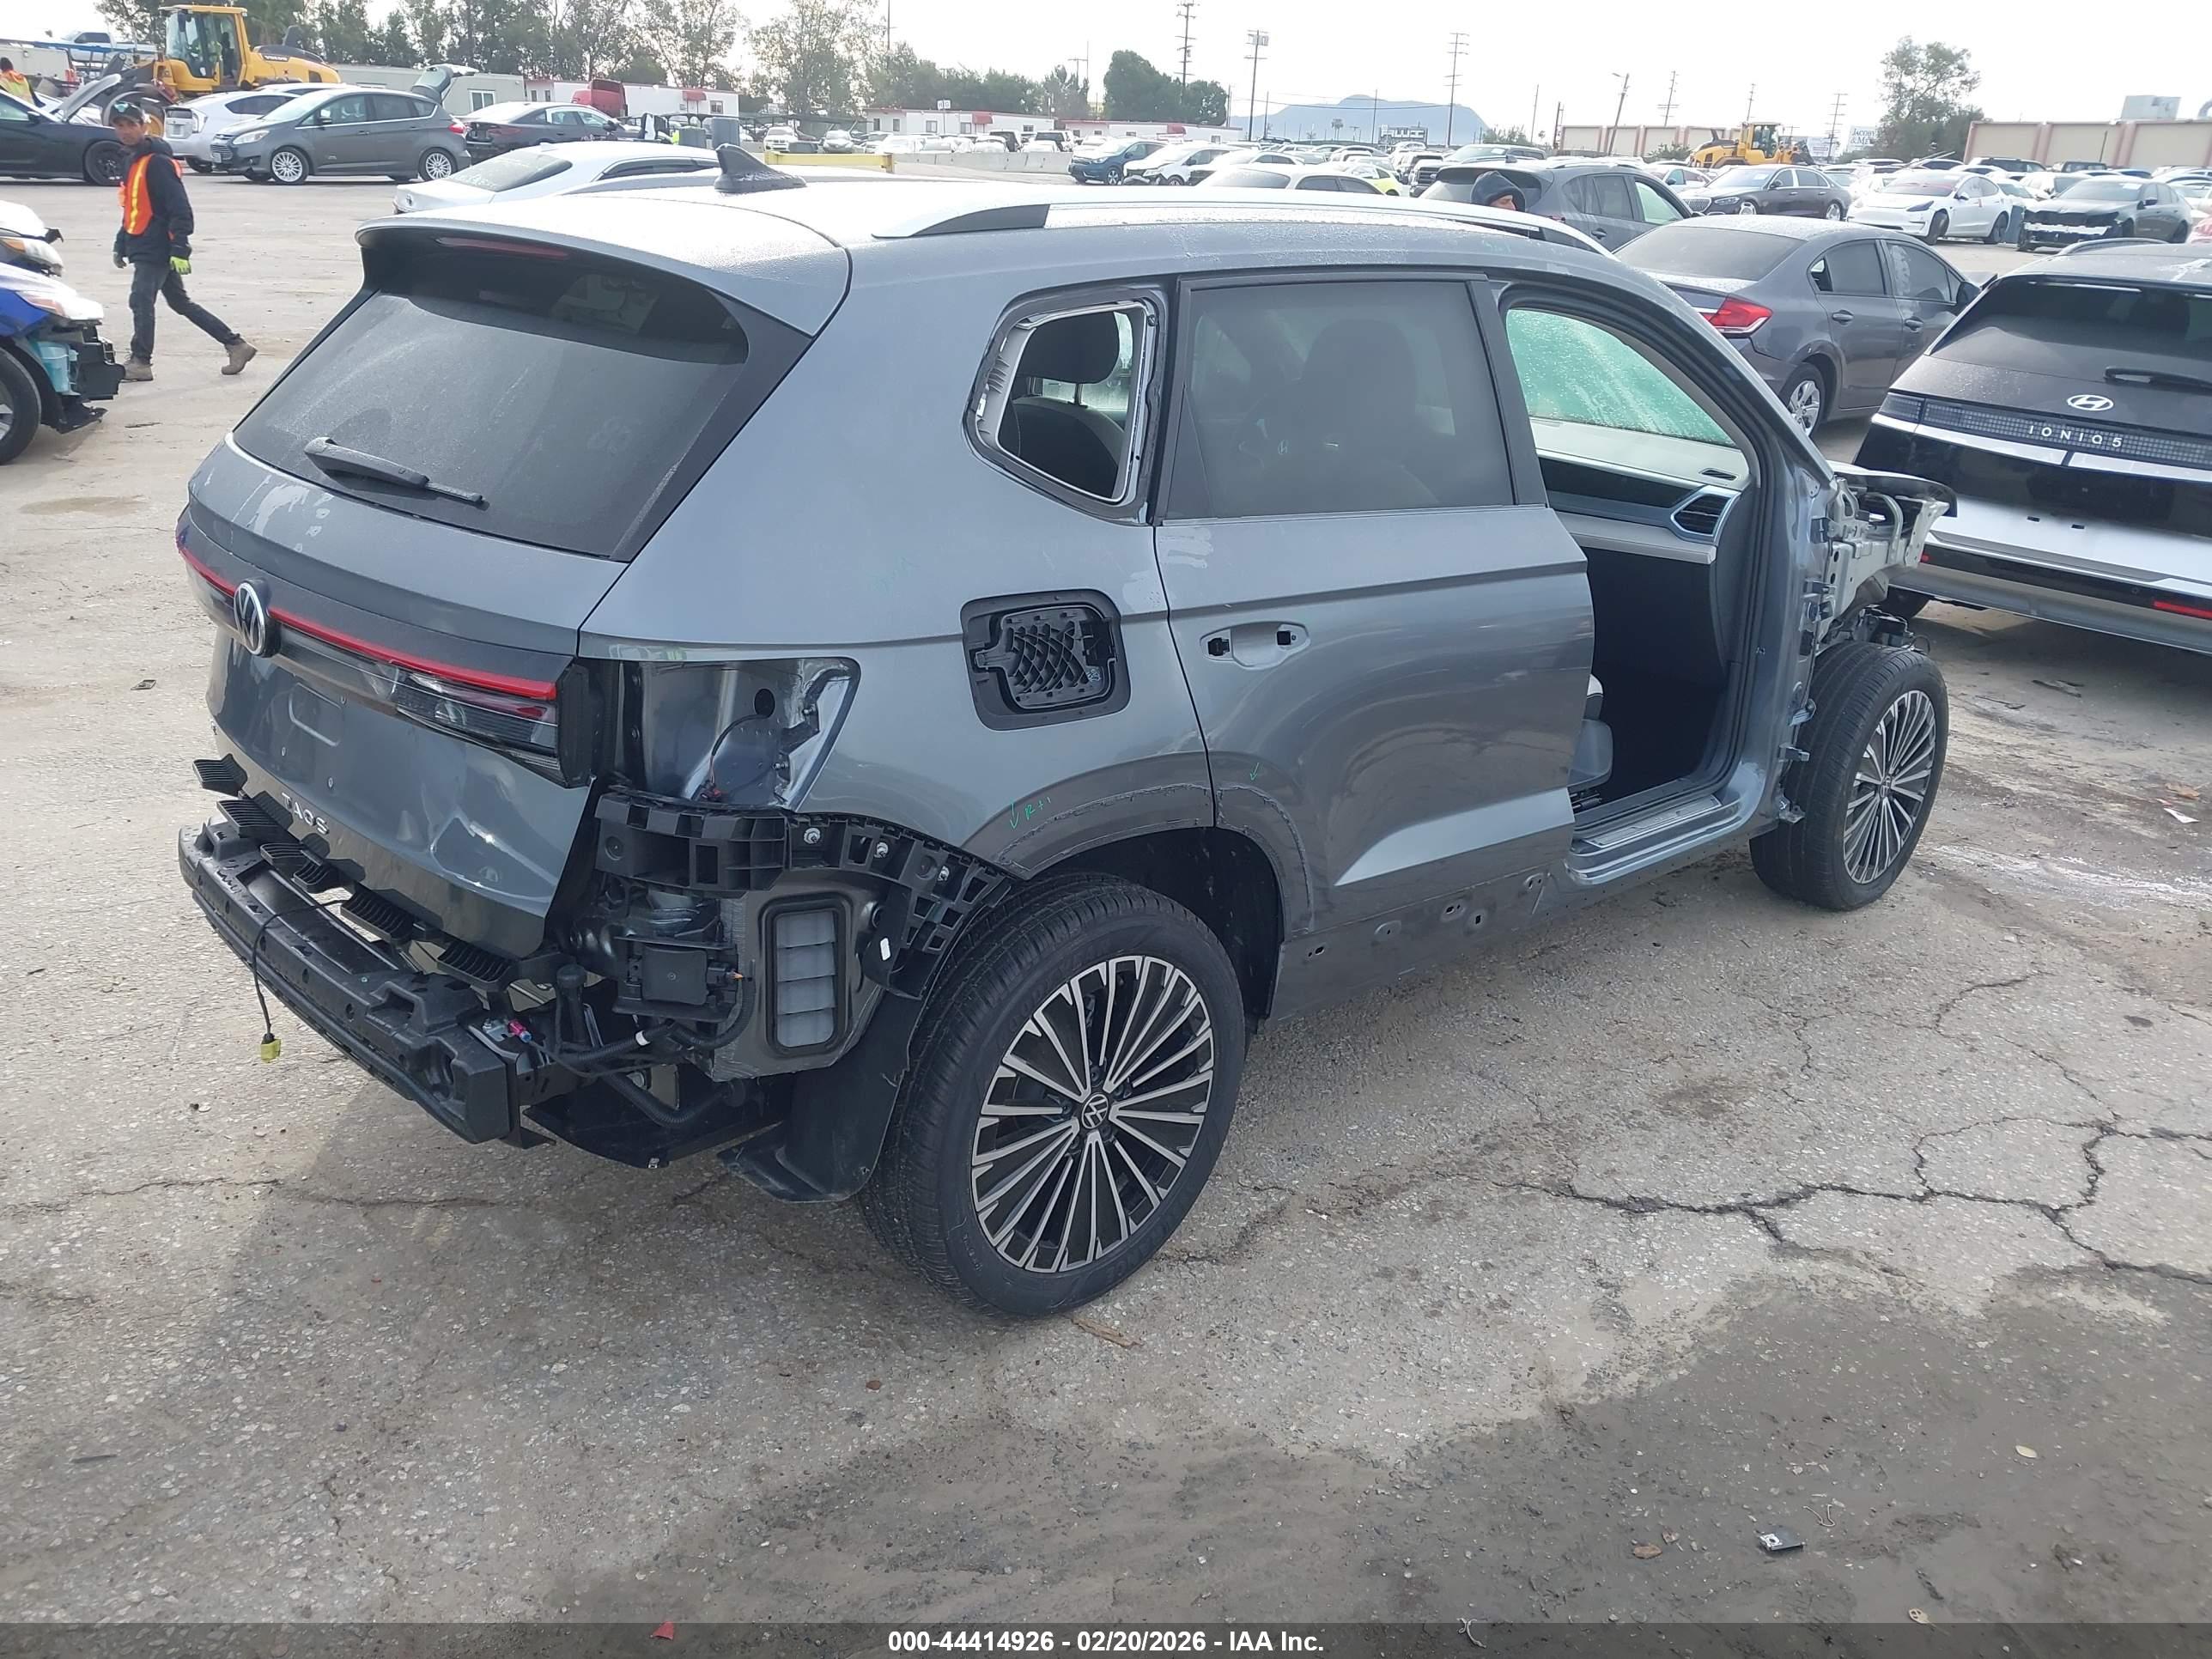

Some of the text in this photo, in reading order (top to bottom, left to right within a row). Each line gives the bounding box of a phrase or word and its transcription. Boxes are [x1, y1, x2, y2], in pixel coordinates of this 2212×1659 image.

[2028, 424, 2123, 447] IONIQ 5
[281, 792, 329, 835] TAOS
